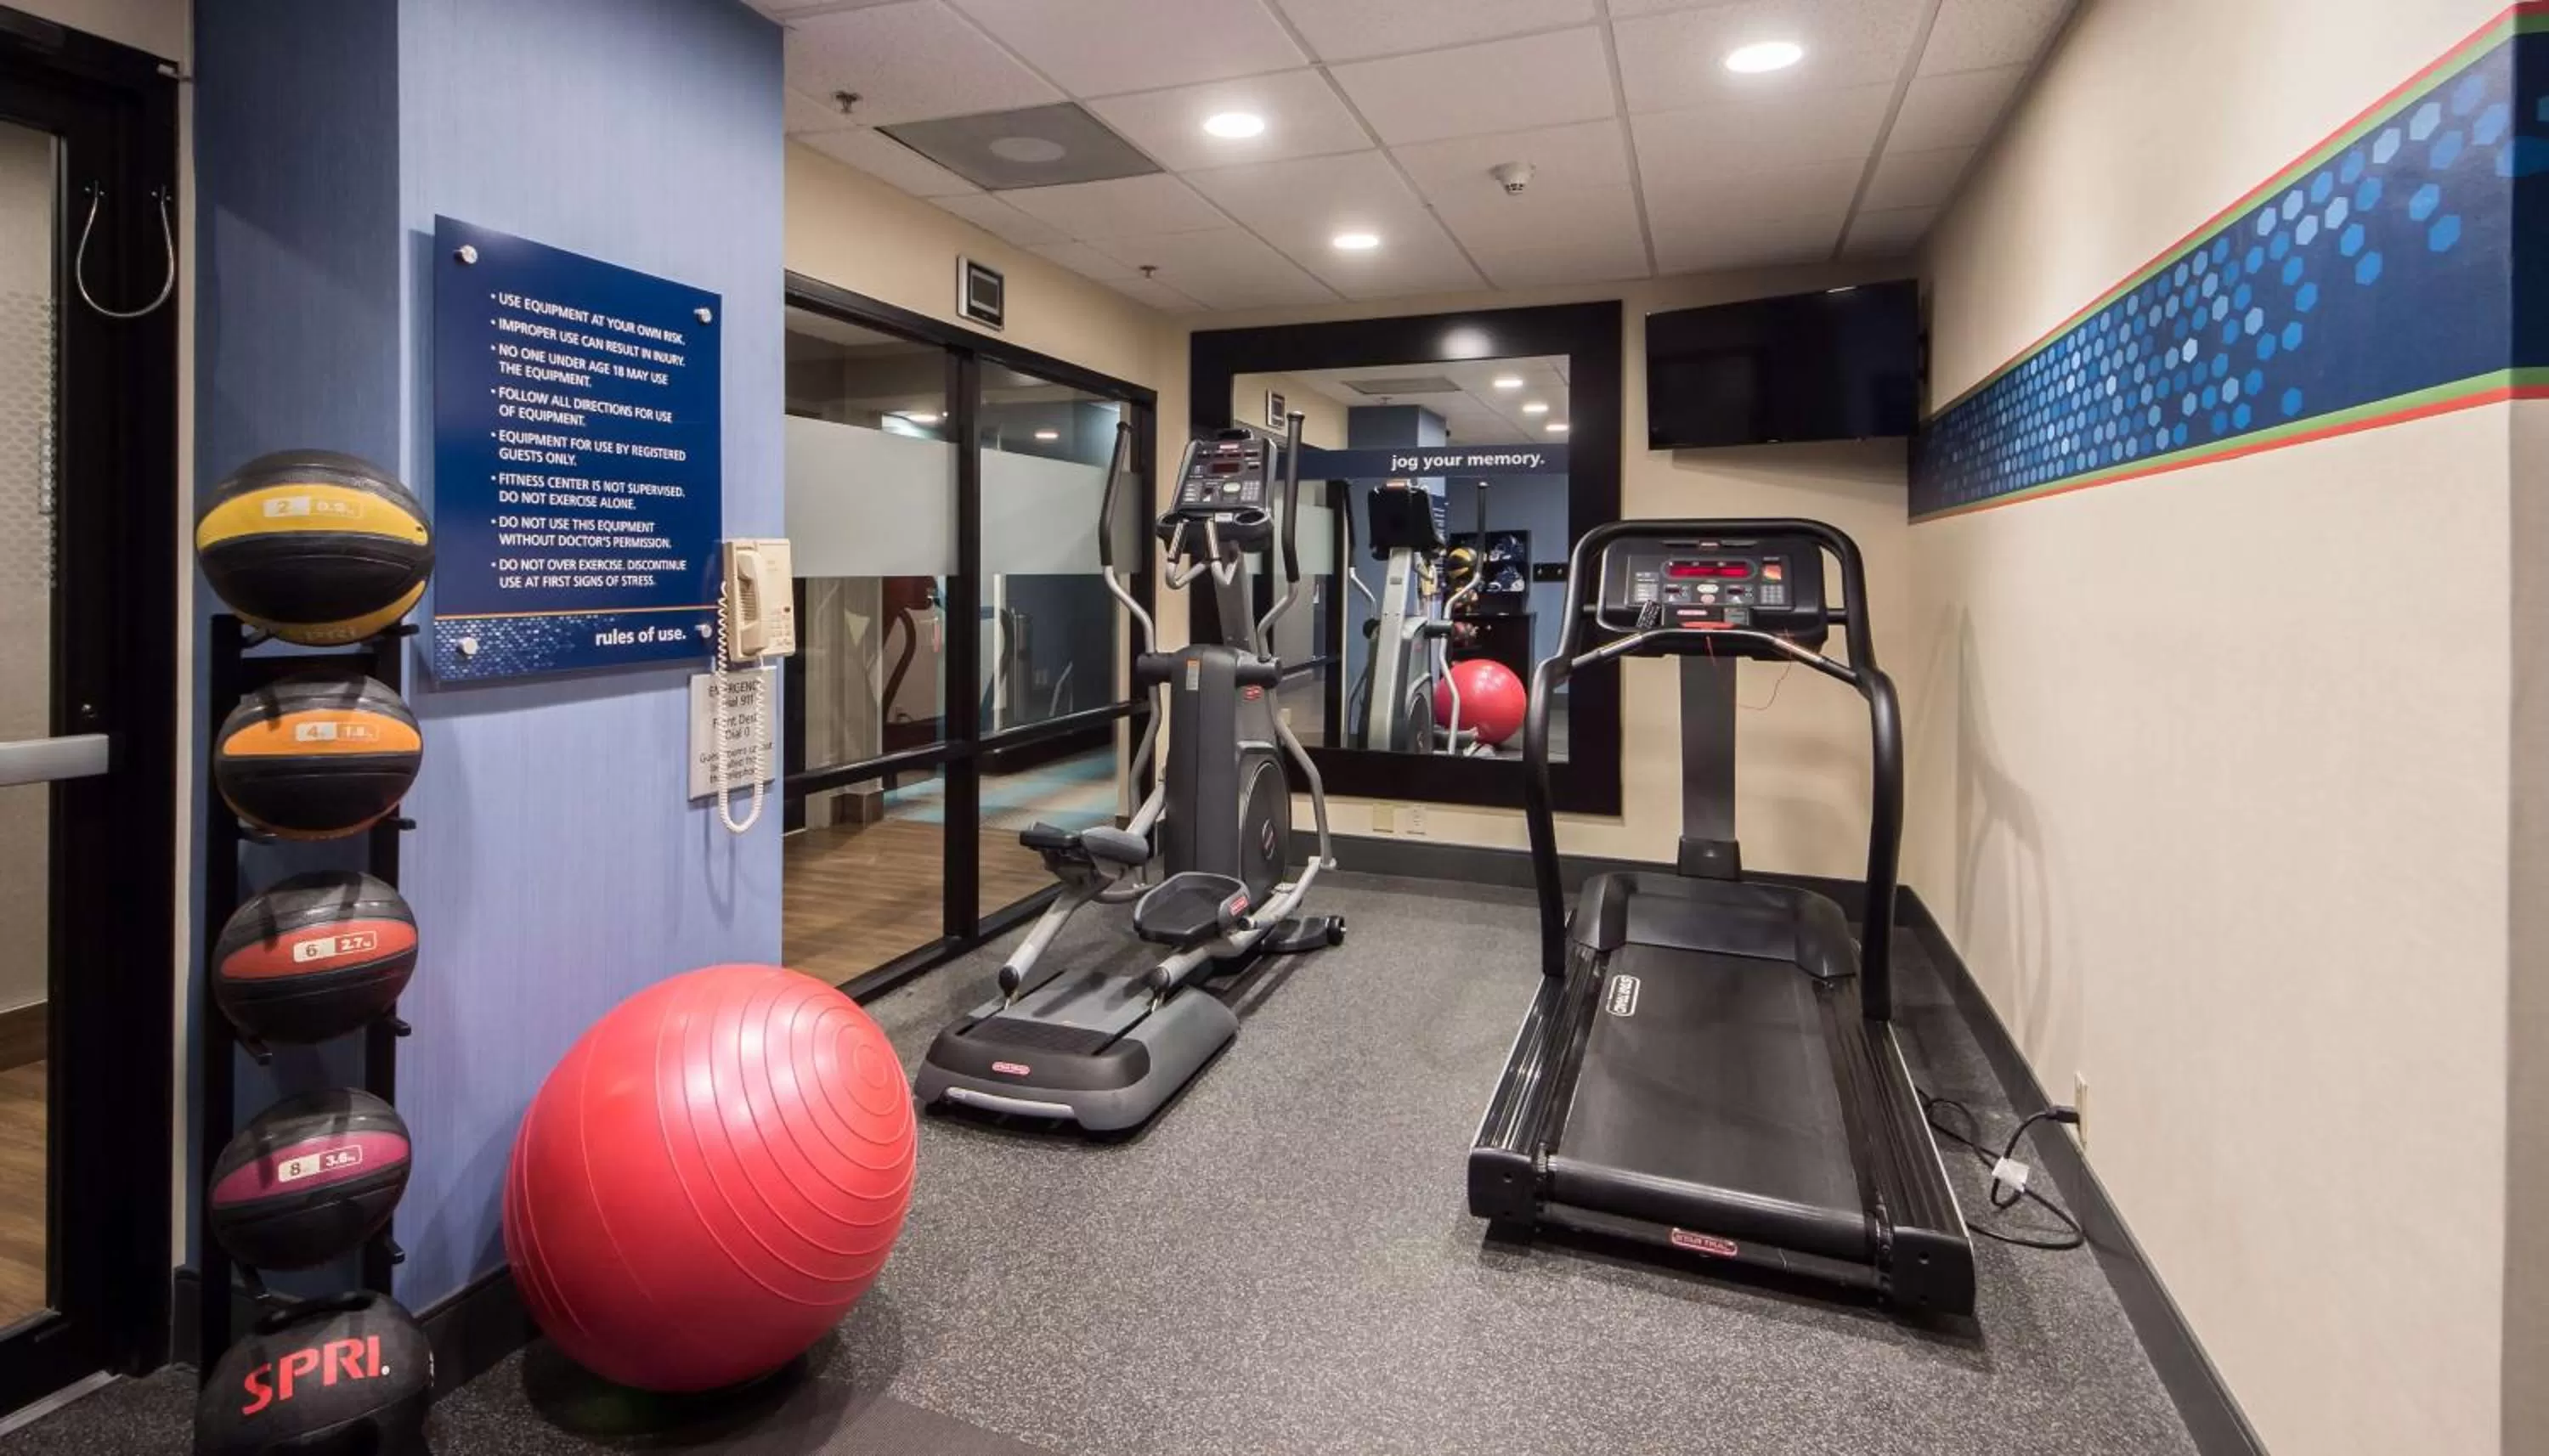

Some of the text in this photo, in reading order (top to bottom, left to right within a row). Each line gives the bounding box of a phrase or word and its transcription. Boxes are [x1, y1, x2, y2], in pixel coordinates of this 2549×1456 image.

[498, 291, 685, 344] USE EQUIPMENT AT YOUR OWN RISK.
[499, 318, 686, 366] IMPROPER USE CAN RESULT IN INJURY.
[499, 343, 668, 385] NO ONE UNDER AGE 18 MAY USE
[499, 360, 591, 387] THE EQUIPMENT.
[498, 386, 672, 422] FOLLOW ALL DIRECTIONS FOR USE
[498, 404, 585, 426] OF EQUIPMENT.
[499, 429, 686, 461] EQUIPMENT FOR USE BY REGISTERED
[498, 447, 577, 466] GUESTS ONLY.
[1391, 453, 1546, 471] jog your memory.
[499, 472, 685, 497] FITNESS CENTER IS NOT SUPERVISED.
[499, 490, 636, 510] DO NOT EXERCISE ALONE.
[498, 516, 655, 533] DO NOT USE THIS EQUIPMENT
[498, 533, 671, 548] WITHOUT DOCTOR'S PERMISSION.
[499, 558, 686, 570] DO NOT OVER EXERCISE. DISCONTINUE
[499, 575, 654, 588] USE AT FIRST SIGNS OF STRESS.
[595, 626, 687, 645] rules of use.
[740, 695, 754, 706] 911
[307, 725, 318, 738] 4
[306, 944, 318, 957] 6
[290, 1162, 301, 1176] 8
